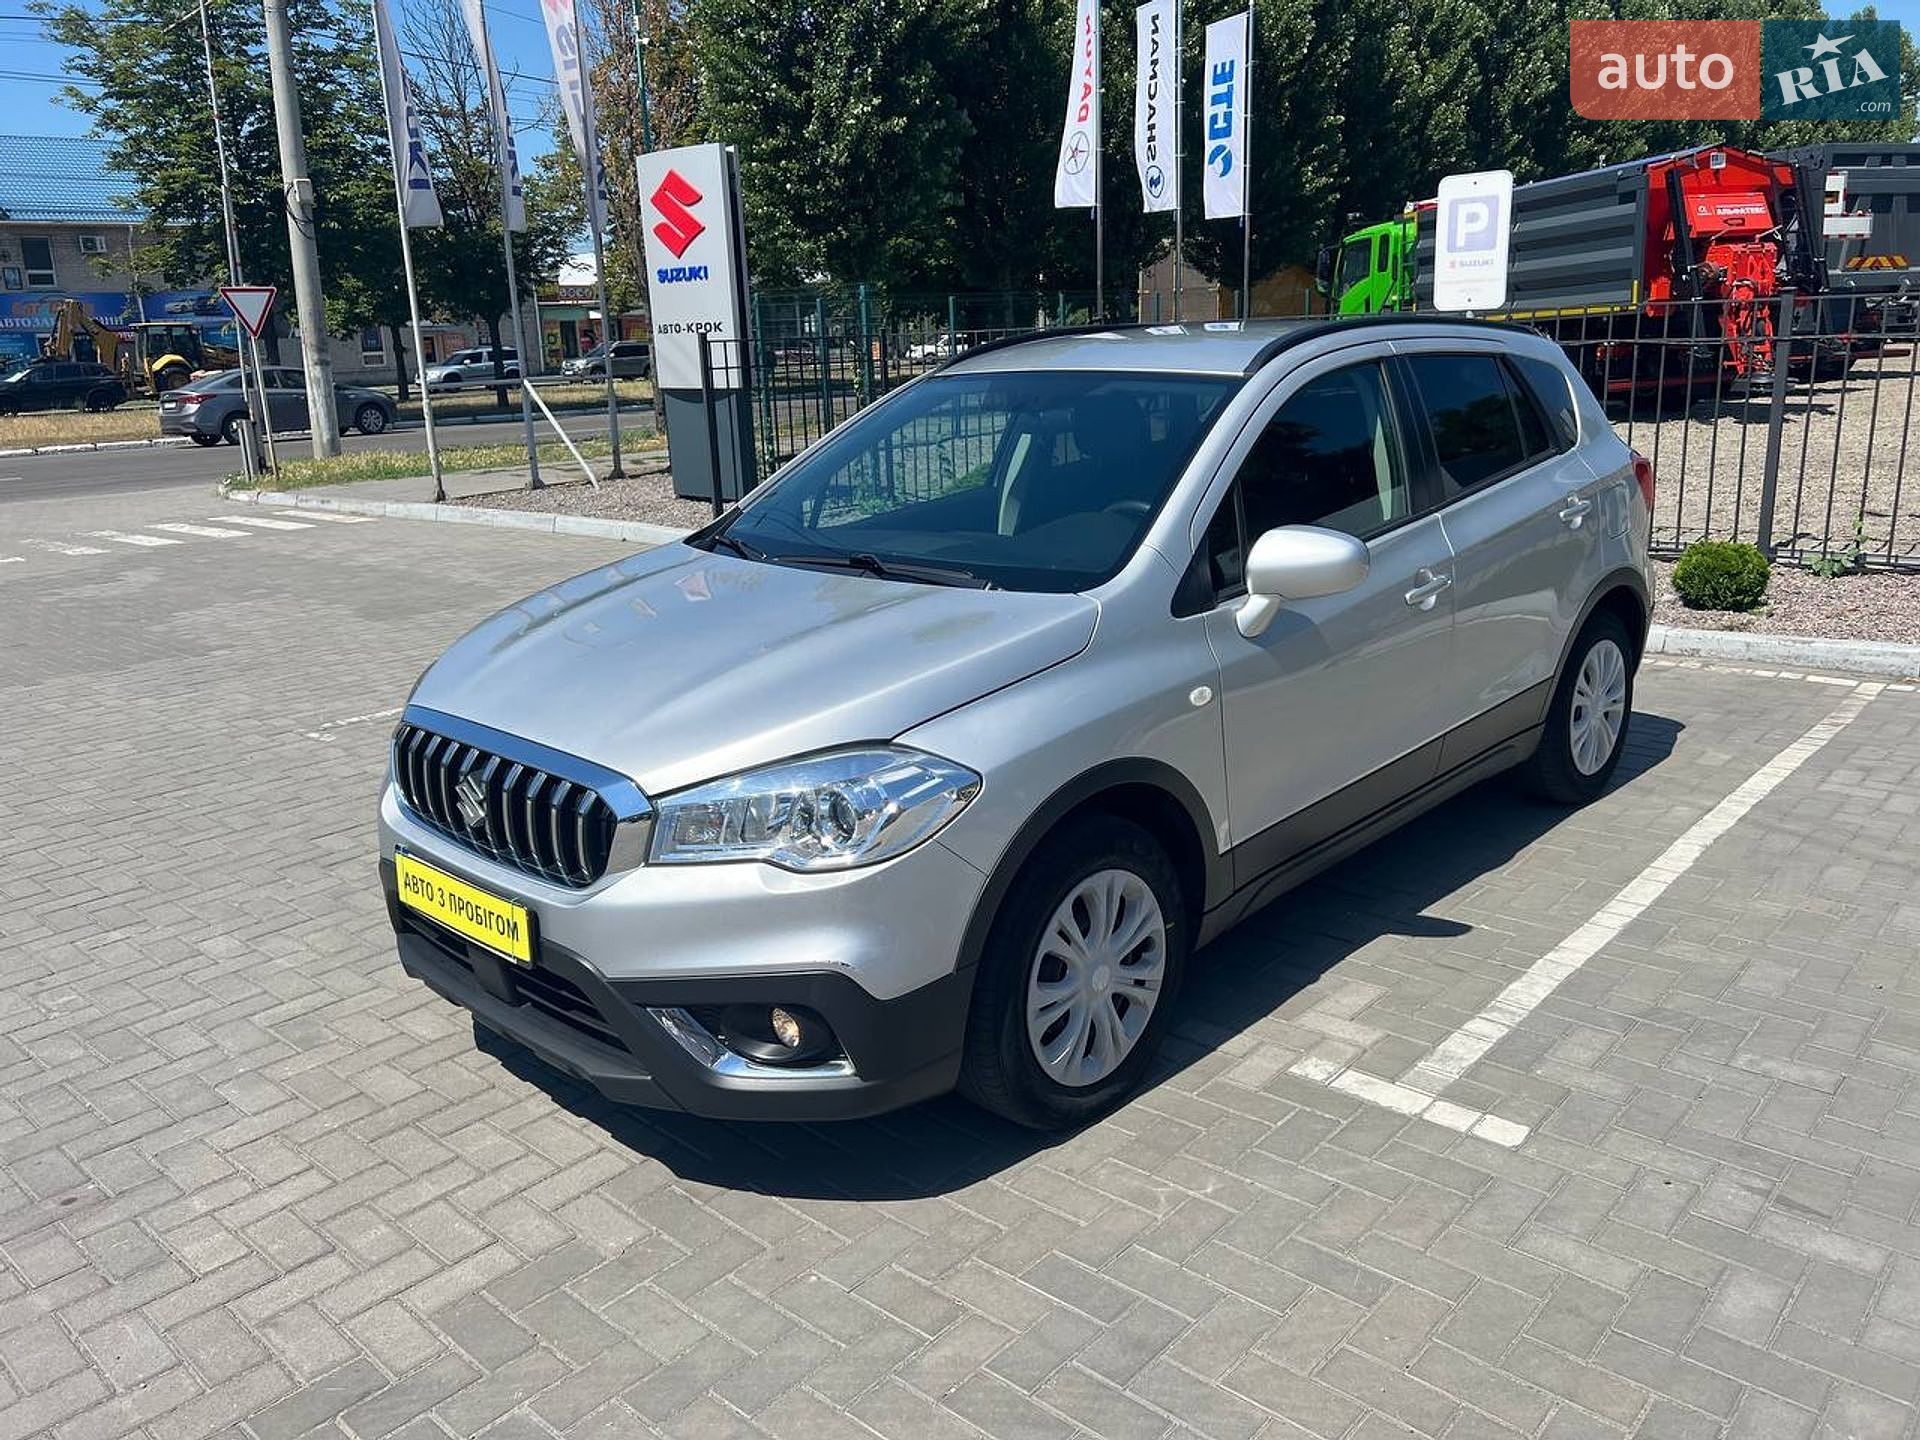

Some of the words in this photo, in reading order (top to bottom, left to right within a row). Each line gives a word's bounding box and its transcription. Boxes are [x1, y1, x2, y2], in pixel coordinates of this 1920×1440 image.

[1456, 202, 1490, 249] P
[656, 265, 709, 284] SUZUKI
[657, 321, 723, 334] АВТО-КРОК
[404, 871, 435, 902] АВТО
[437, 887, 446, 908] З
[448, 892, 520, 943] ПРОБІГОМ
